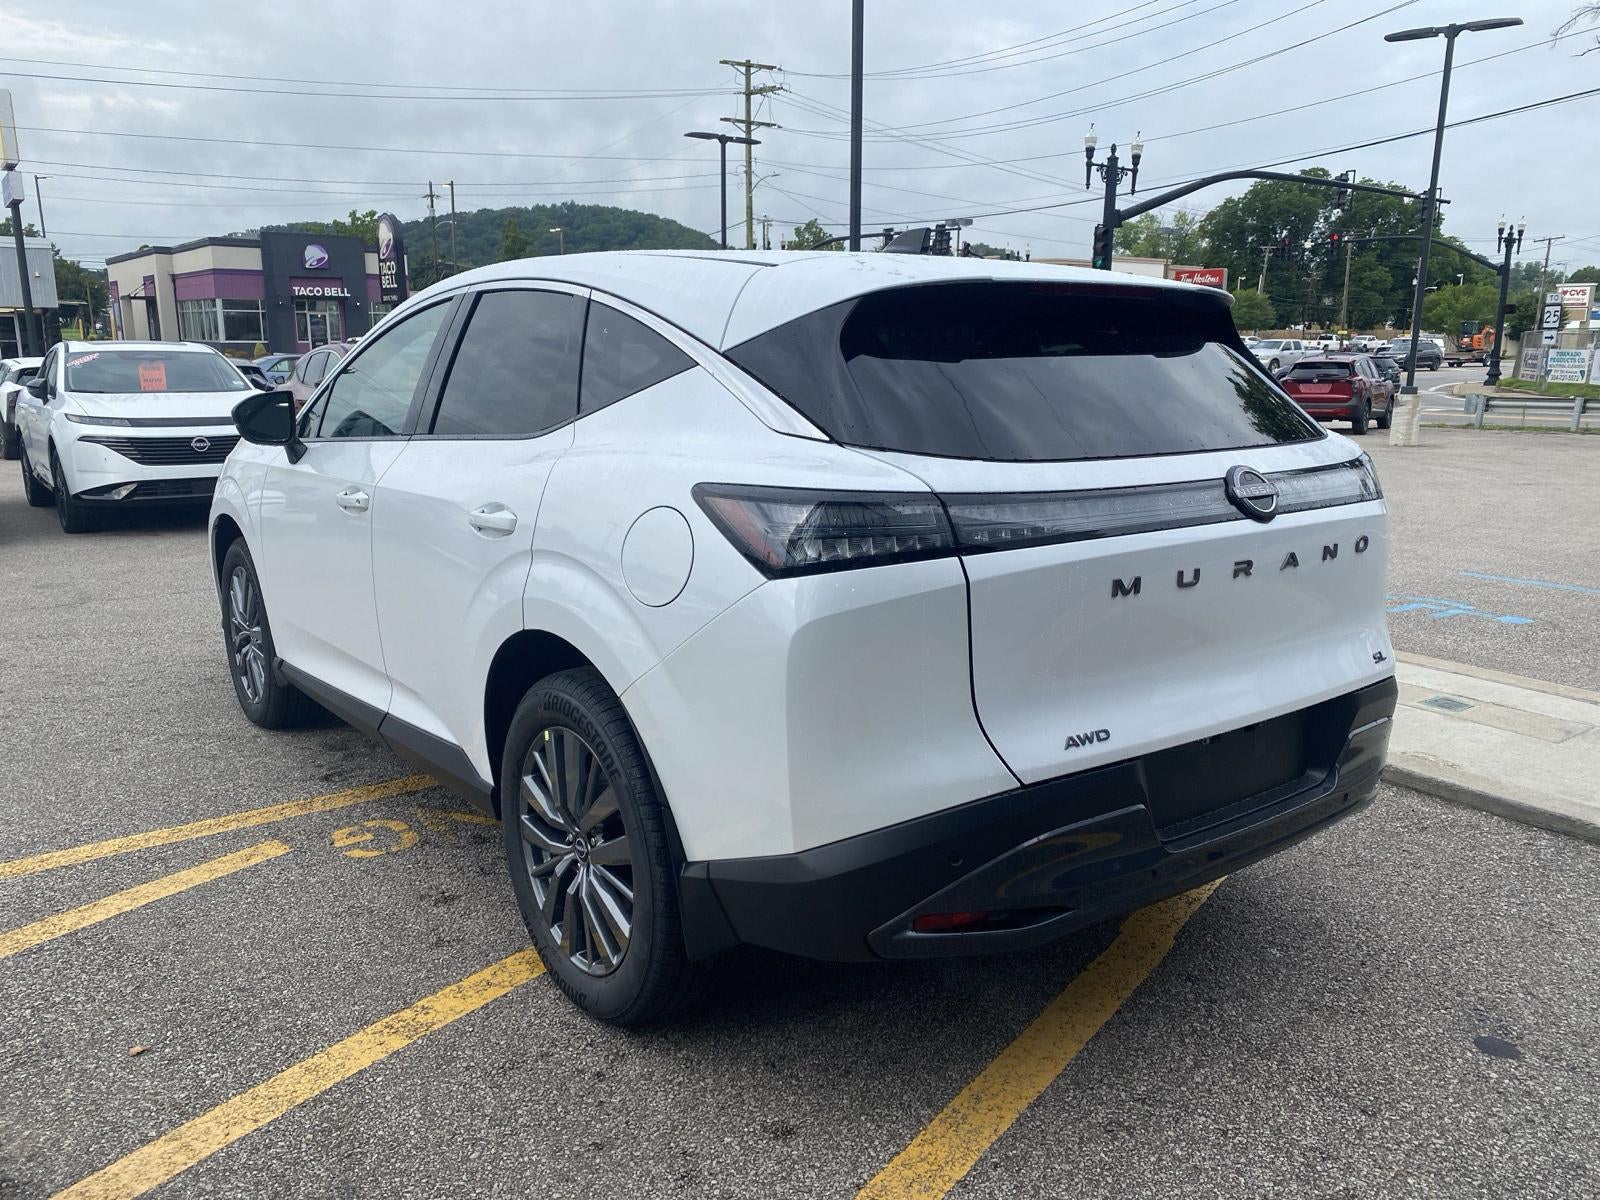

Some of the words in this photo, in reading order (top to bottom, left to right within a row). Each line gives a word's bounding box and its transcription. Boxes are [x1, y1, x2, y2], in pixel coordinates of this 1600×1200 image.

[380, 261, 396, 274] TACO
[382, 275, 398, 288] BELL
[1180, 274, 1193, 283] Tim
[1193, 272, 1219, 283] Hortons
[293, 286, 323, 296] TACO
[324, 287, 351, 297] BELL
[1550, 294, 1560, 302] TO
[1544, 310, 1560, 324] 25
[1111, 535, 1369, 598] MURANO
[1373, 651, 1387, 664] SL
[543, 691, 622, 783] BRIDGESTONE
[1064, 729, 1110, 751] AWD
